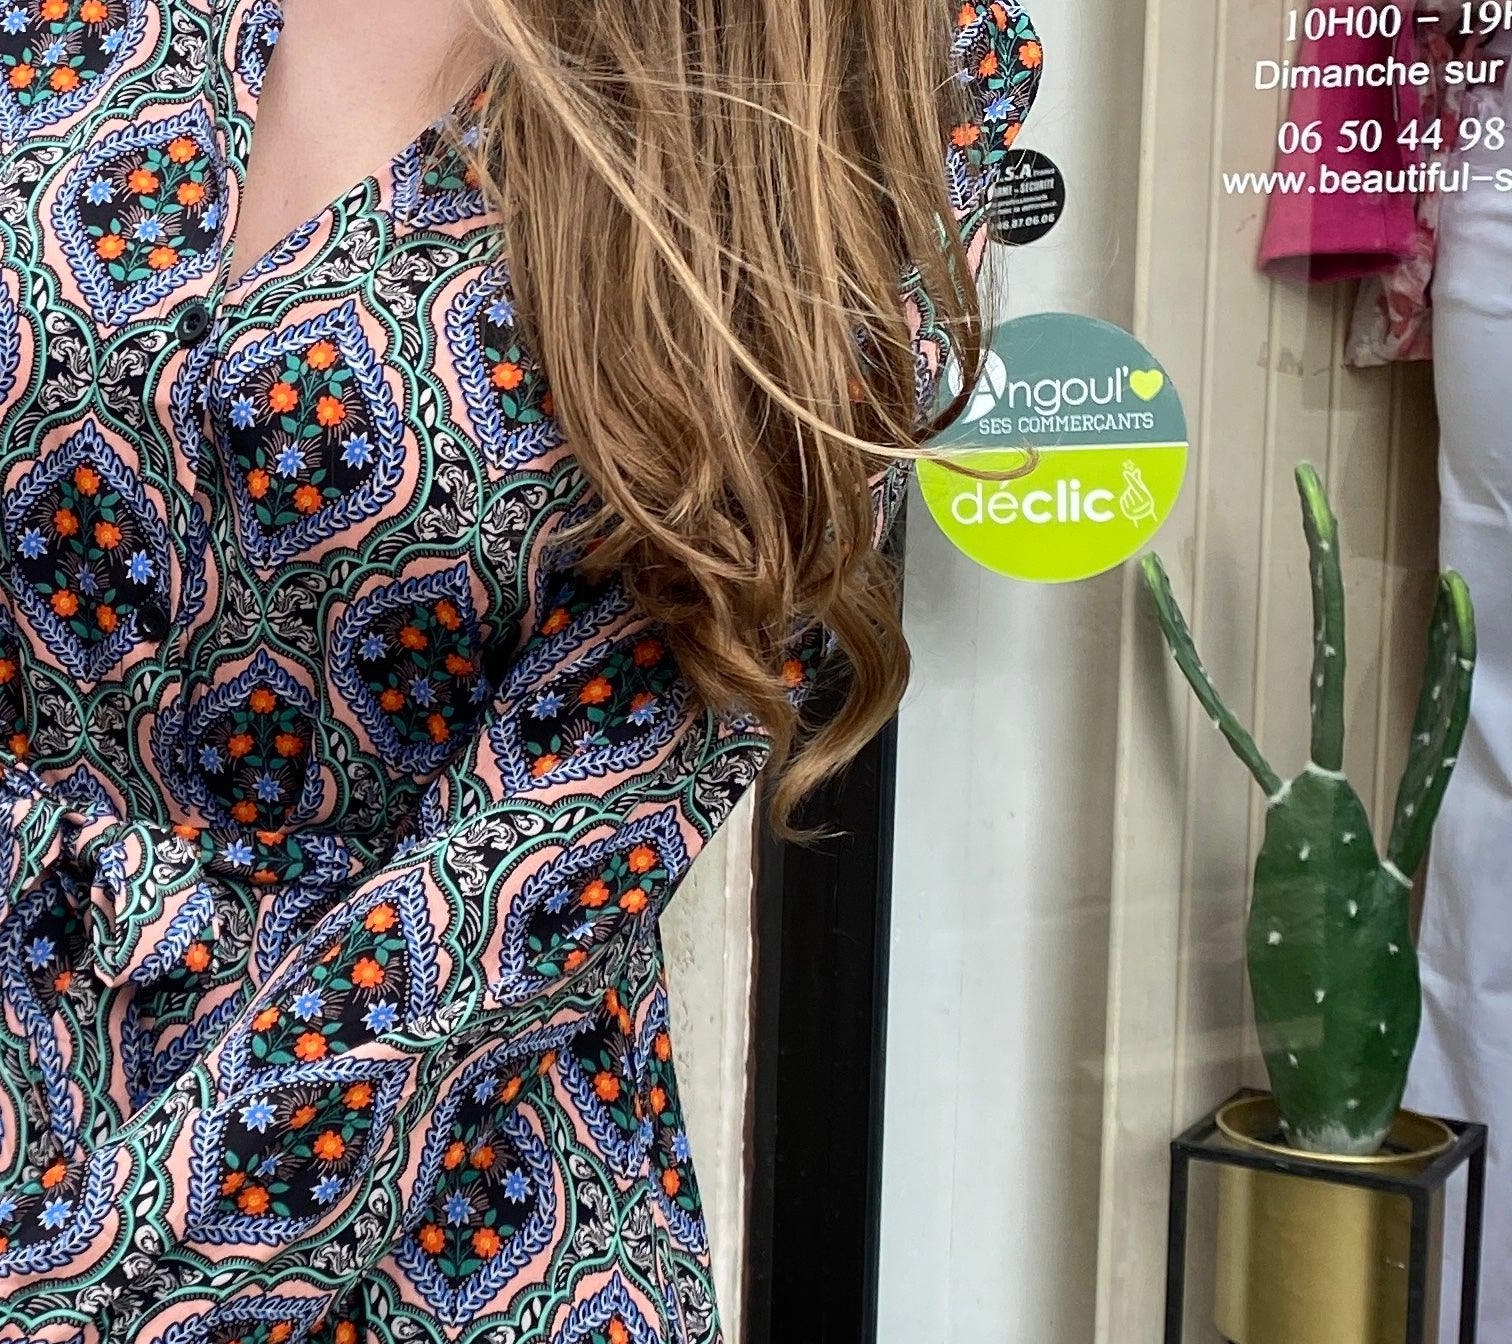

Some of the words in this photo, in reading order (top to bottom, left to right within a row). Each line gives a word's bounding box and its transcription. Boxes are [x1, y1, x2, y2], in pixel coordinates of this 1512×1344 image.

[1287, 4, 1401, 42] 10H00
[1254, 56, 1430, 90] Dimanche
[1444, 59, 1504, 84] sur
[1278, 120, 1323, 154] 06
[1337, 120, 1382, 153] 50
[1396, 119, 1443, 151] 44
[1459, 117, 1505, 152] 98
[979, 418, 1012, 435] SES
[1018, 412, 1154, 434] COMMERÇANTS
[951, 478, 1116, 525] déclic
